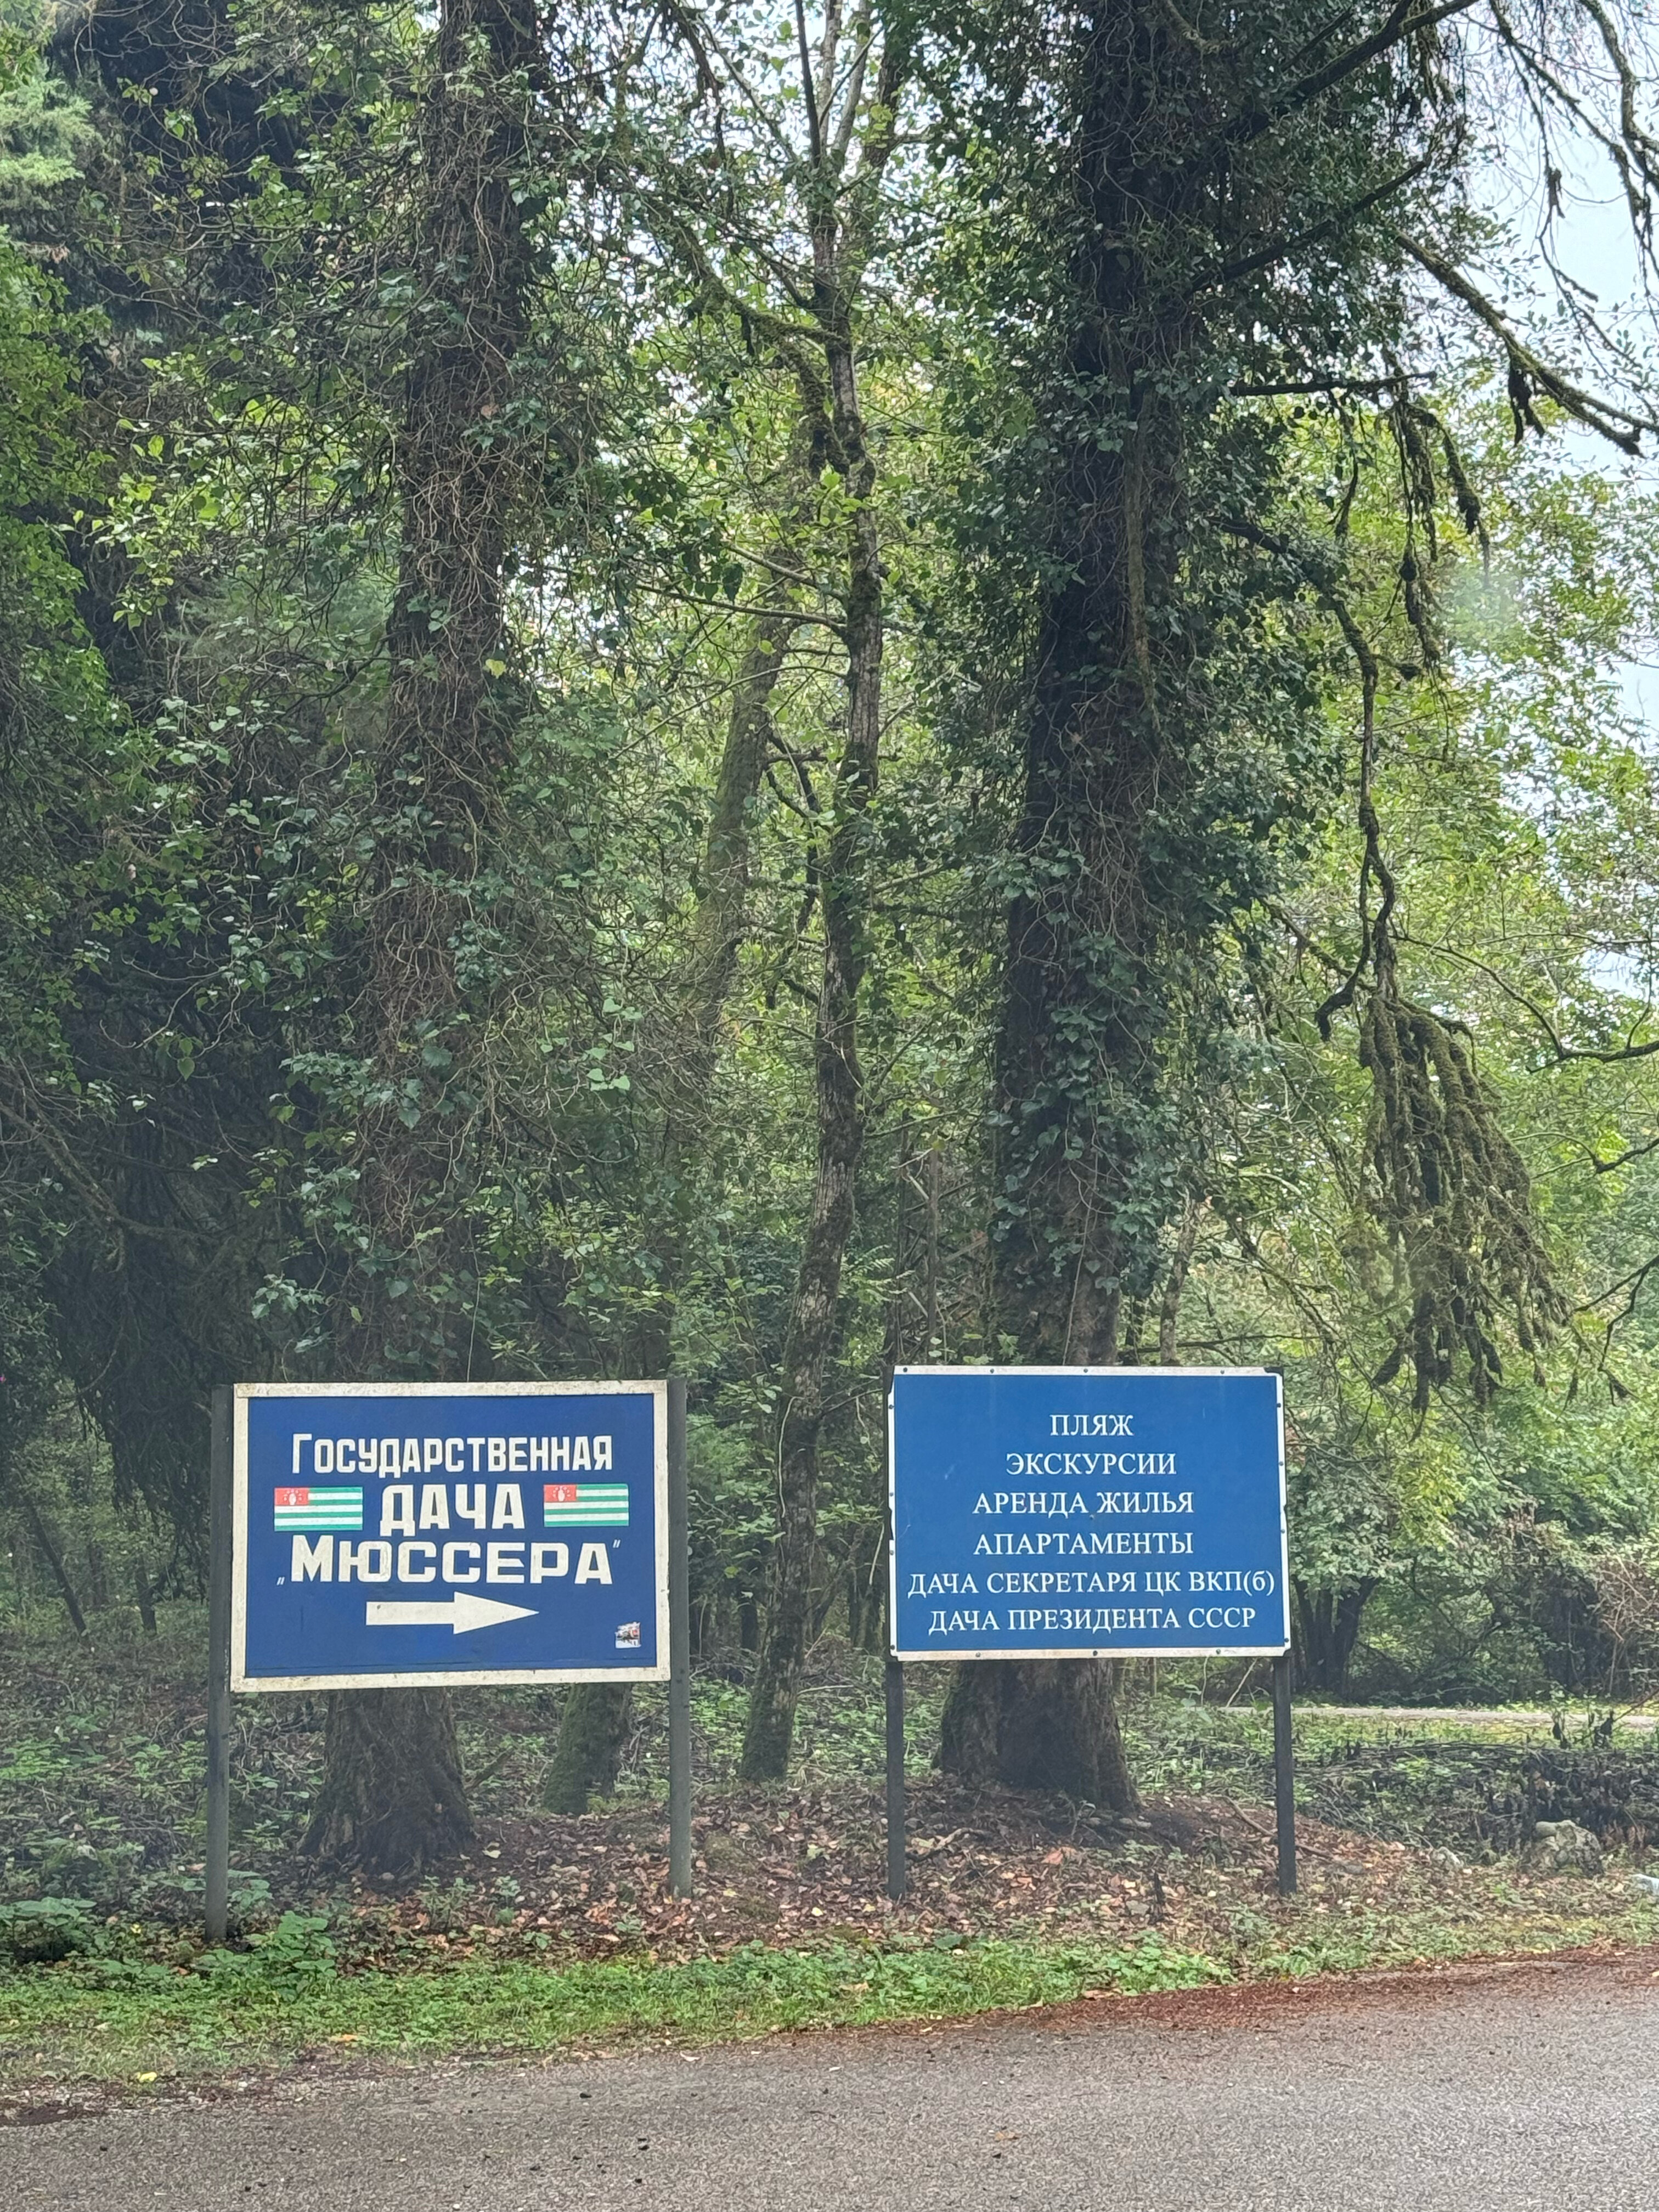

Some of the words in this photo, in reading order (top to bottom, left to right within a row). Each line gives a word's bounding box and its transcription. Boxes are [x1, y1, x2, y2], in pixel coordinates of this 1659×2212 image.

[1049, 1414, 1134, 1436] ПЛЯЖ
[292, 1433, 612, 1479] ГОСУДАРСТВЕННАЯ
[1006, 1453, 1177, 1475] ЭКСКУРСИИ
[380, 1483, 525, 1536] ДАЧА
[972, 1492, 1089, 1518] АРЕНДА
[1096, 1492, 1194, 1514] ЖИЛЬЯ
[973, 1533, 1194, 1555] АПАРТАМЕНТЫ
[907, 1573, 979, 1599] ДАЧА
[986, 1572, 1136, 1594] СЕКРЕТАРЯ
[1144, 1572, 1181, 1595] ЦК
[1188, 1570, 1275, 1597] ВКП(б)
[928, 1610, 1000, 1635] ДАЧА
[1007, 1608, 1180, 1634] ПРЕЗИДЕНТА
[1188, 1607, 1256, 1629] СССР
